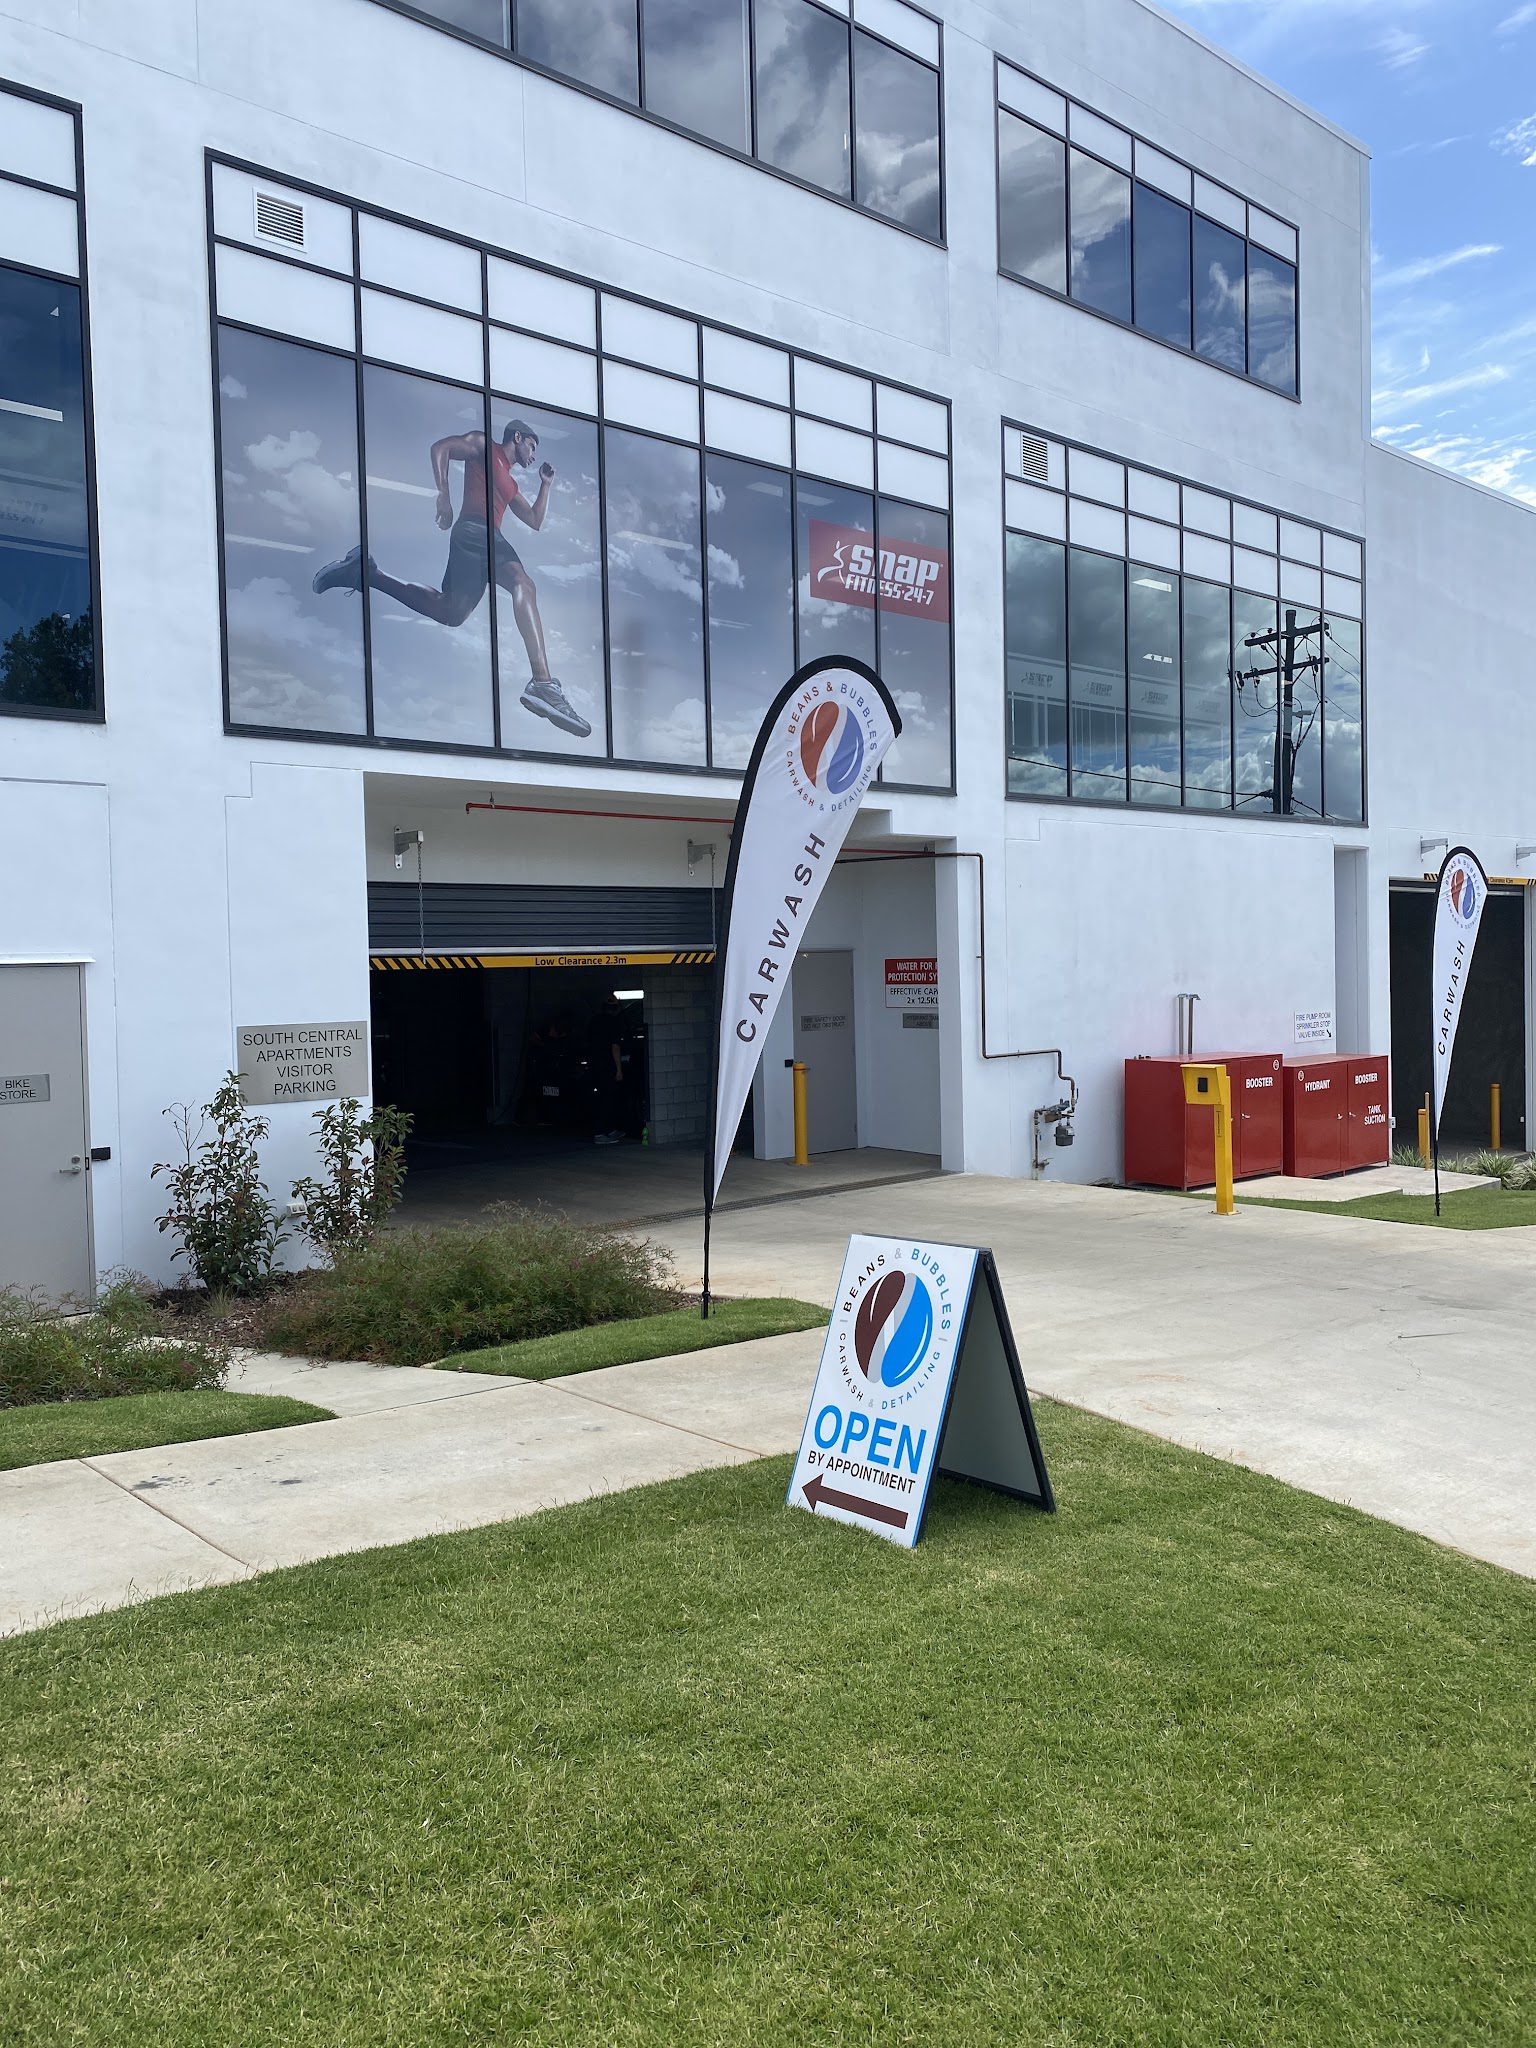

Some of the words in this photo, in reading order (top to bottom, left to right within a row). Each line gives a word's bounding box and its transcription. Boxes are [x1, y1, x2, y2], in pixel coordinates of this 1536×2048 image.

[788, 686, 819, 734] BEANS
[826, 681, 833, 692] &
[840, 683, 877, 751] BUBBLES
[786, 751, 815, 806] CARWASH
[736, 833, 826, 1043] CARWASH
[535, 957, 554, 966] Low
[558, 956, 603, 966] Clearance
[605, 955, 627, 965] 2.3m
[896, 962, 918, 971] WATER
[920, 961, 933, 971] FOR
[887, 972, 927, 982] PROTECTION
[890, 987, 922, 995] EFFECTIVE
[1437, 940, 1465, 1055] CARWASH
[1306, 1012, 1318, 1020] PUMP
[243, 1032, 294, 1046] SOUTH
[298, 1029, 363, 1043] CENTRAL
[256, 1045, 352, 1062] APARTMENTS
[276, 1063, 333, 1078] VISITOR
[5, 1079, 30, 1089] BIKE
[1246, 1076, 1273, 1088] BOOSTER
[1355, 1072, 1378, 1084] BOOSTER
[274, 1080, 336, 1095] PARKING
[1305, 1079, 1331, 1092] HYDRANT
[0, 1089, 36, 1100] STORE
[1368, 1104, 1382, 1114] TANK
[1364, 1113, 1386, 1125] SUCTION
[843, 1254, 885, 1312] BEANS
[894, 1248, 902, 1259] &
[911, 1248, 952, 1330] BUBBLES
[839, 1333, 864, 1402] CARWASH
[882, 1351, 940, 1410] DETAILING
[814, 1404, 927, 1475] OPEN
[808, 1450, 825, 1467] BY
[826, 1456, 916, 1494] APPOINTMENT
